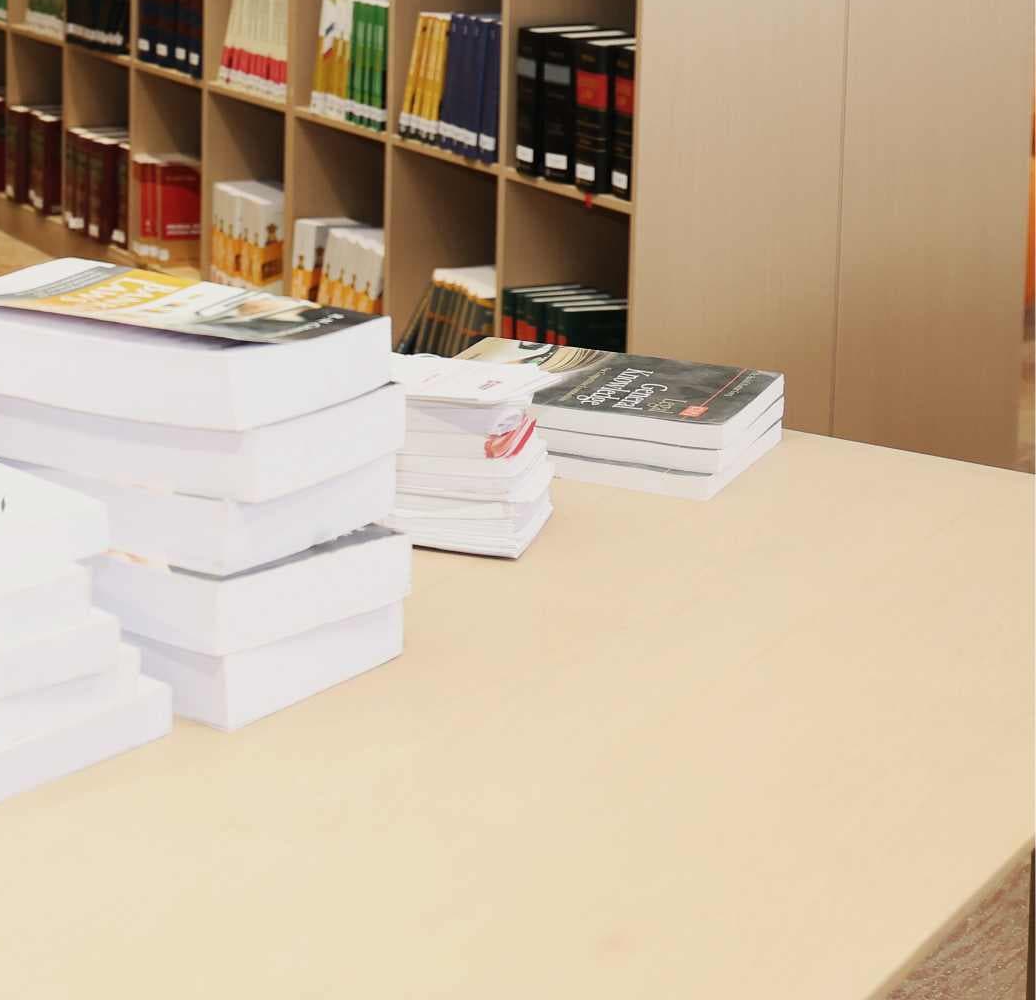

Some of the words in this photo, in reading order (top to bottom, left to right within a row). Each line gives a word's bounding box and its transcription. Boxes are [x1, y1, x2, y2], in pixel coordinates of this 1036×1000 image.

[576, 368, 654, 406] Knowledge
[612, 383, 668, 410] General
[646, 399, 688, 414] Legal
